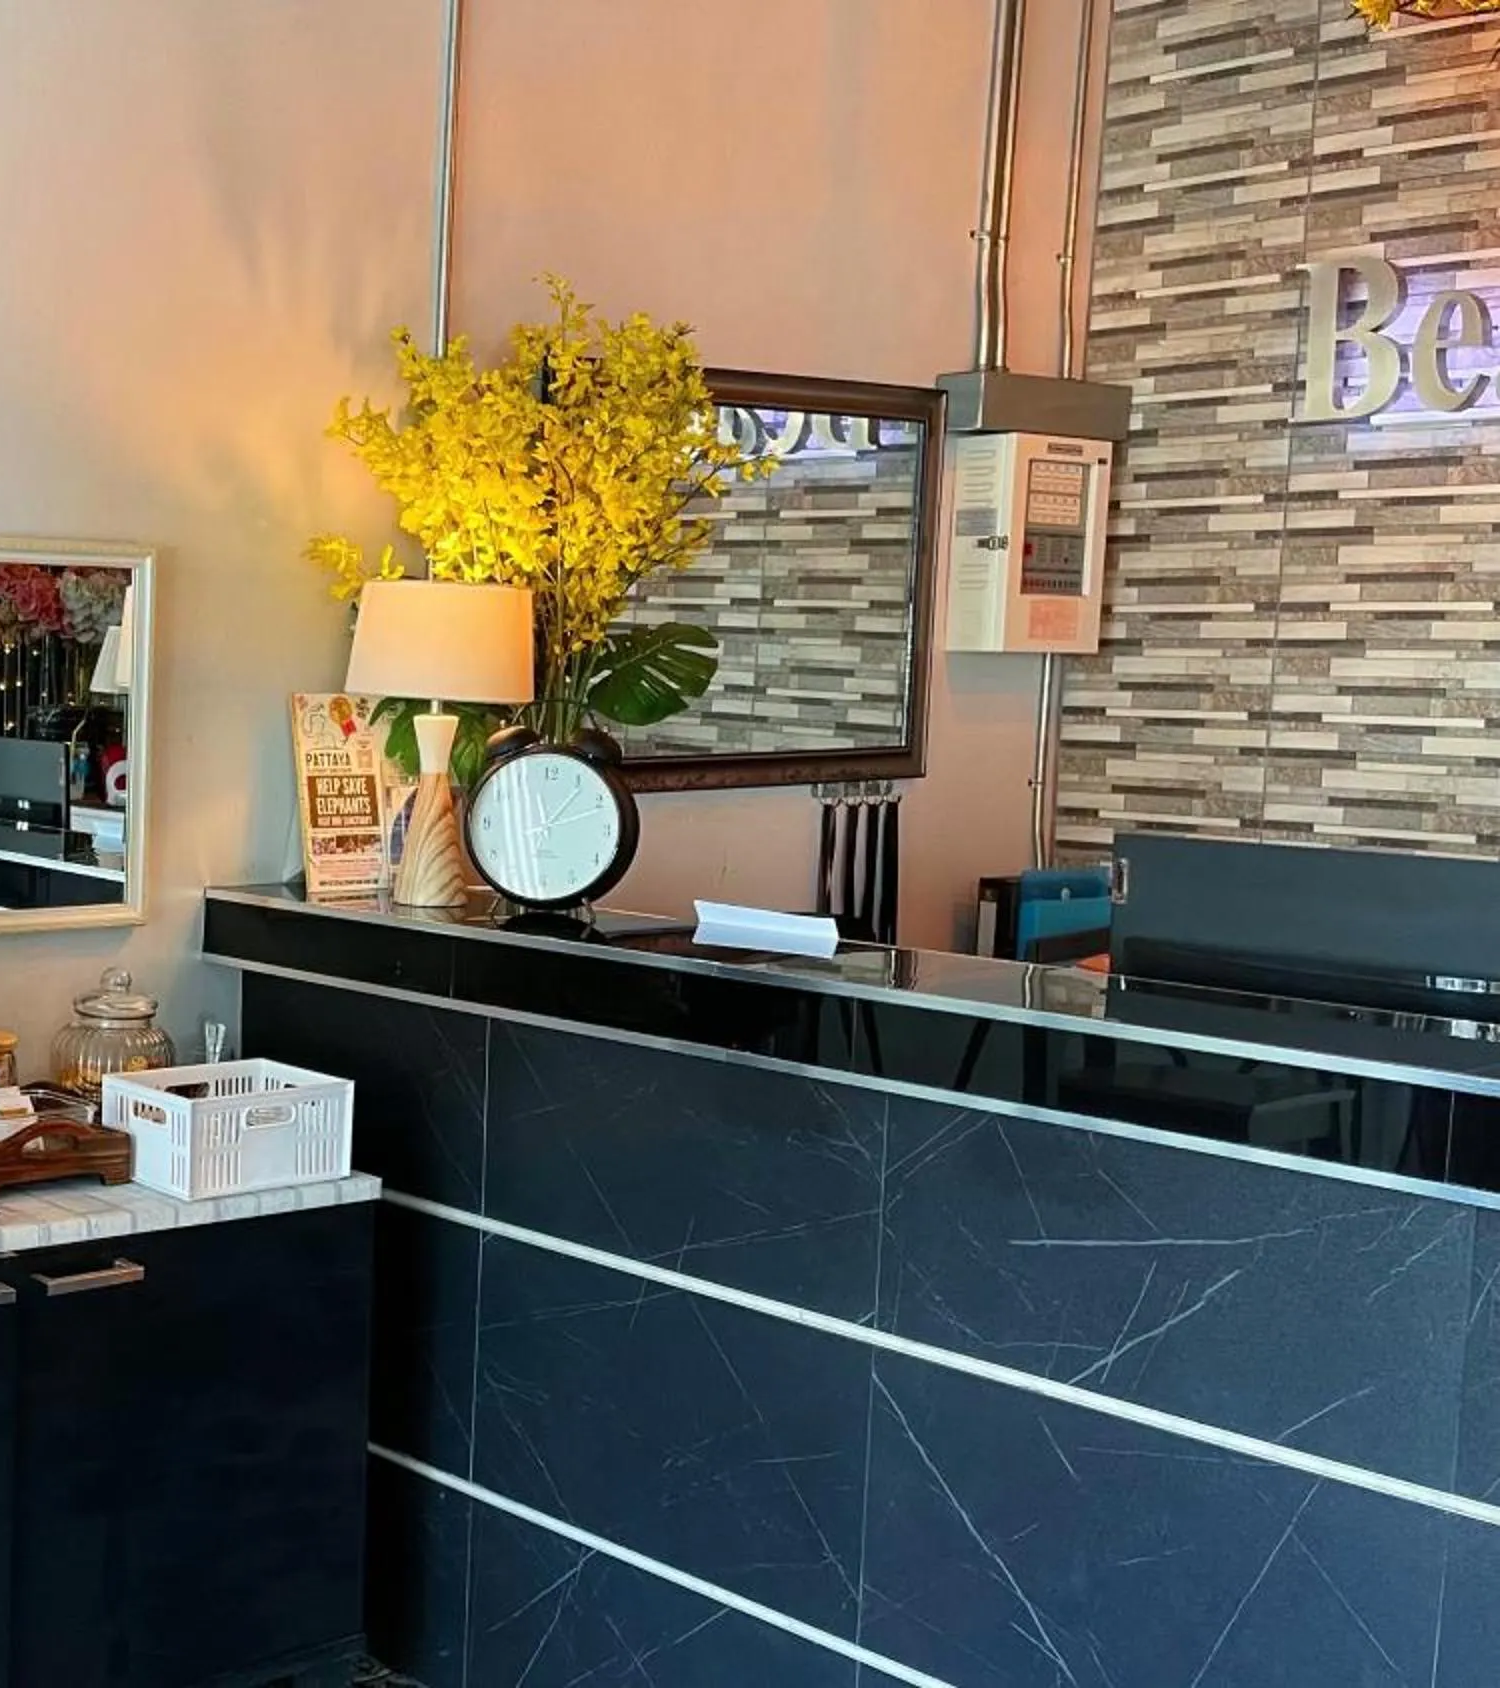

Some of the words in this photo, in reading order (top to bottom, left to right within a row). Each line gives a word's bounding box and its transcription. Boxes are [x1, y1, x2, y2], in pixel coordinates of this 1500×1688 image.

[1289, 254, 1500, 422] Be
[305, 752, 351, 768] PATTAYA
[315, 777, 341, 796] HELP
[342, 776, 369, 795] SAVE
[315, 796, 372, 815] ELEPHANTS
